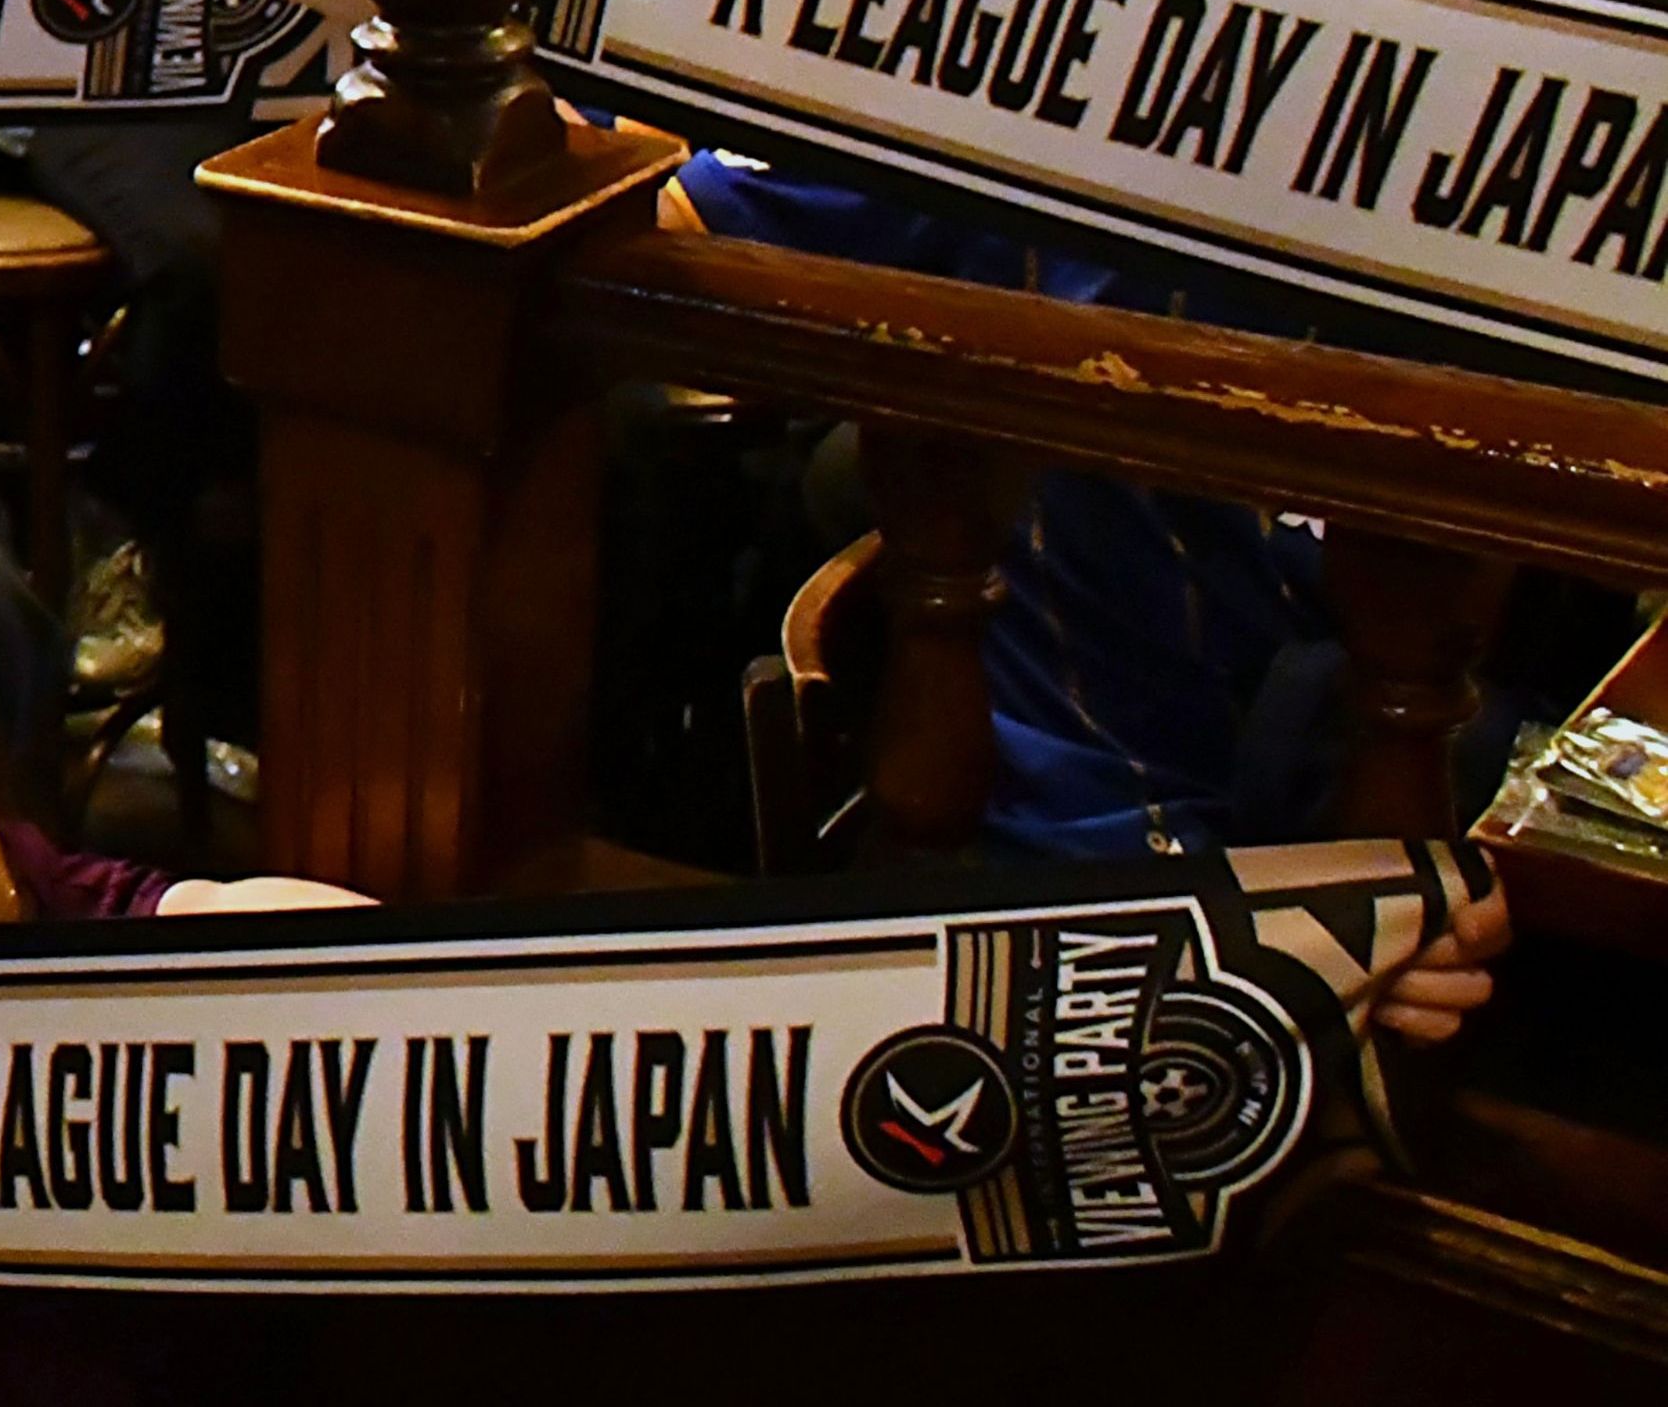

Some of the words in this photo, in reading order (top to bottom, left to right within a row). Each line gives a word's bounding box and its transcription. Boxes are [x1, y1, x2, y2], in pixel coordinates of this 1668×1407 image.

[1288, 30, 1441, 212] IN
[1409, 66, 1668, 284] JAPA
[1053, 930, 1158, 1078] PARTY
[220, 1037, 379, 1215] DAY
[401, 1033, 492, 1215] IN
[512, 1023, 816, 1215] JAPAN
[1055, 1090, 1173, 1248] VIEWING
